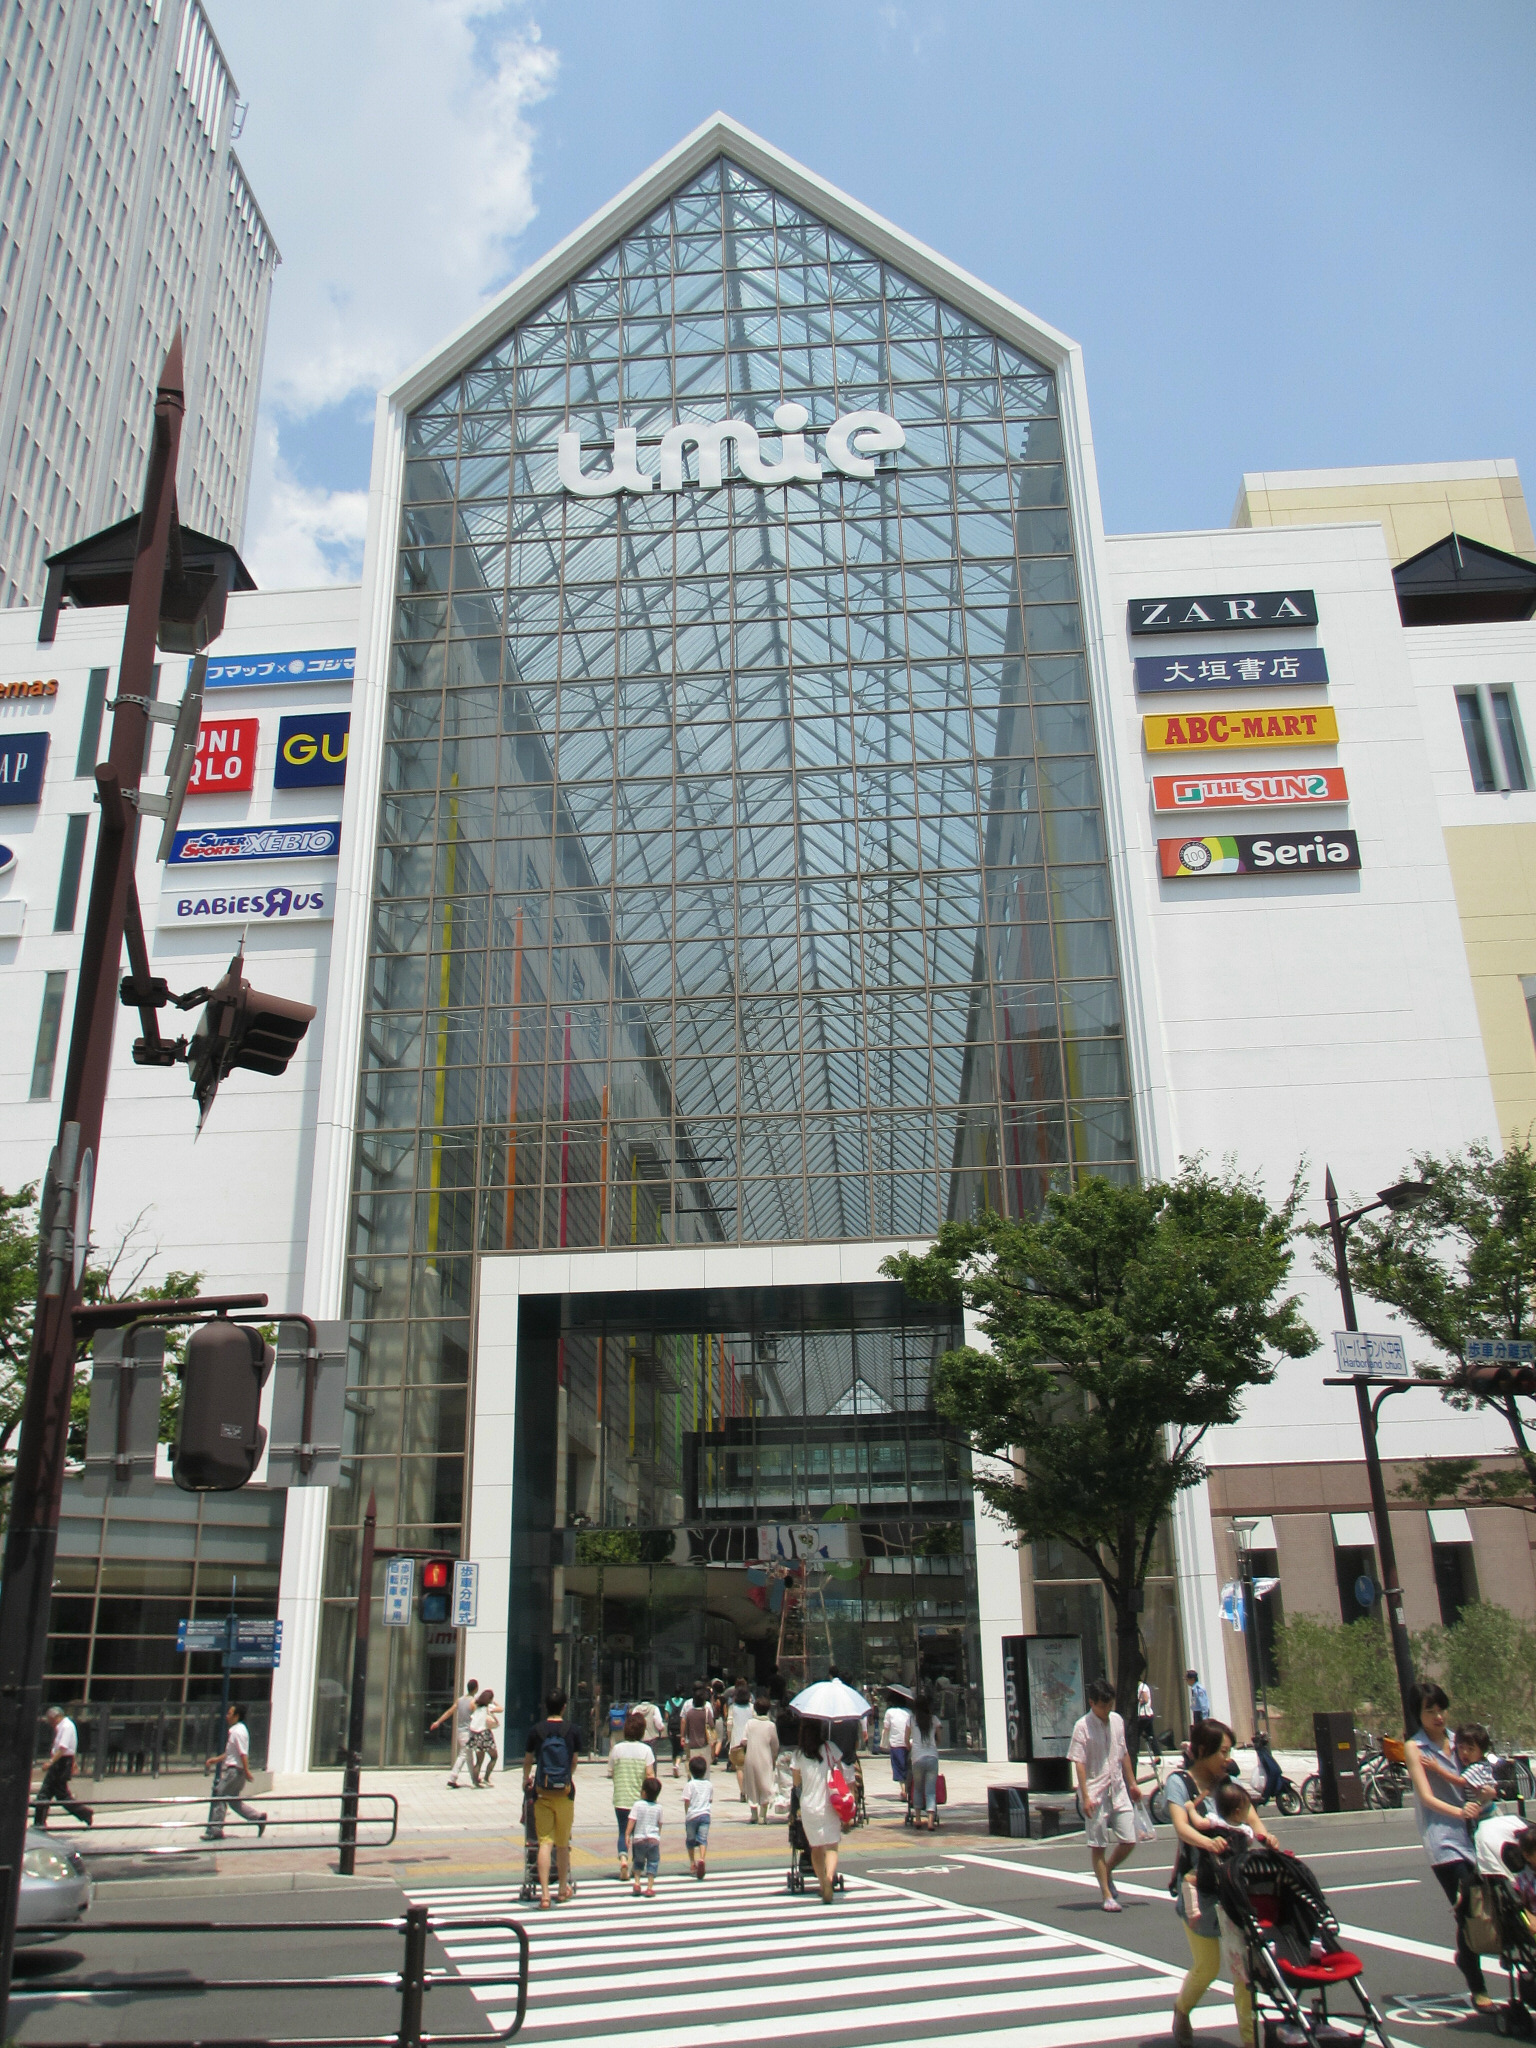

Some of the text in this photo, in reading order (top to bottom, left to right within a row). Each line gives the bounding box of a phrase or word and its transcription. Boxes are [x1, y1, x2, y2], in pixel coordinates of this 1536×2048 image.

[558, 403, 906, 497] umie
[1141, 597, 1307, 625] ZARA
[207, 662, 275, 680] フマップ
[1163, 656, 1300, 683] 大垣書店
[1165, 714, 1317, 745] ABC-MART
[283, 733, 349, 765] GU
[1202, 781, 1243, 795] THE
[182, 844, 240, 857] SPORTS
[200, 833, 247, 847] SUPER
[243, 830, 334, 853] XEBIO
[1251, 836, 1350, 867] Seria
[1185, 849, 1206, 863] 100
[1339, 1339, 1403, 1359] ハーバーランド中央
[1468, 1342, 1533, 1359] 歩車分離式
[459, 1566, 474, 1623] 歩車分離式
[1005, 1656, 1020, 1741] umie
